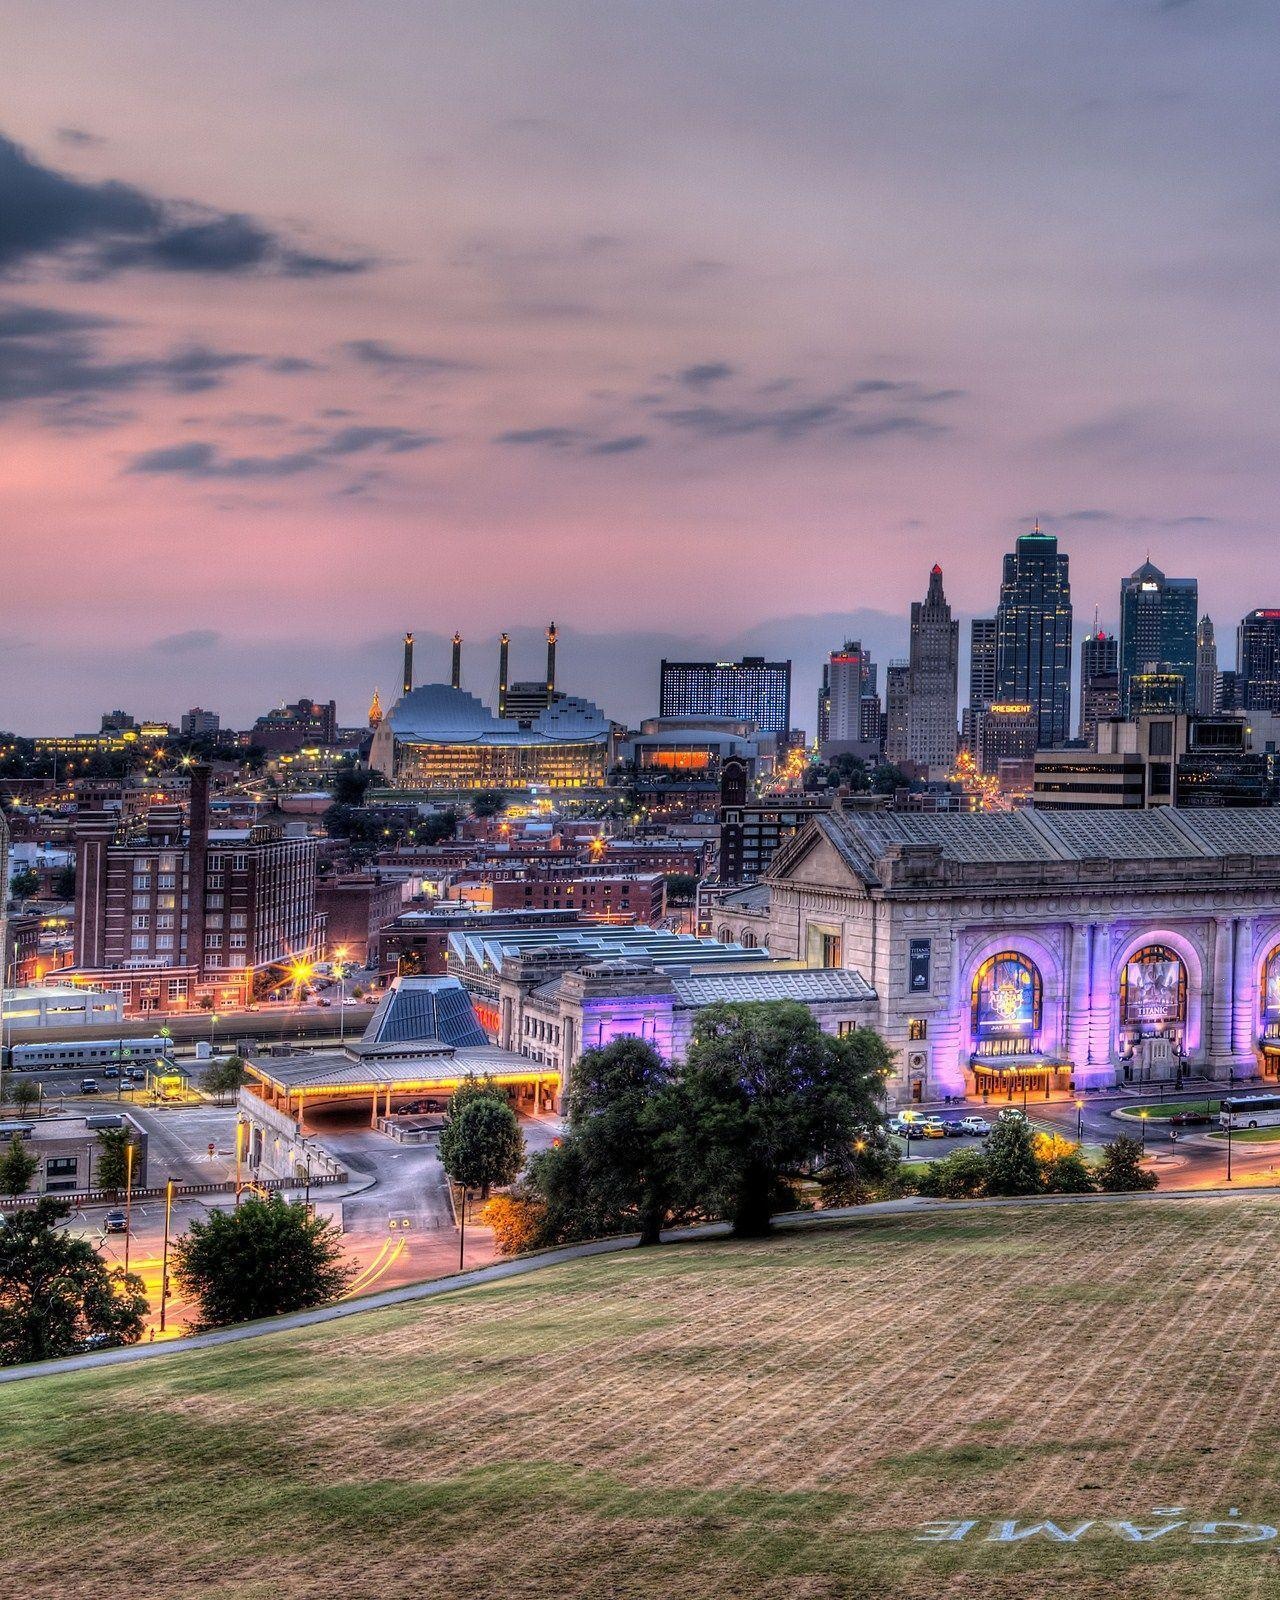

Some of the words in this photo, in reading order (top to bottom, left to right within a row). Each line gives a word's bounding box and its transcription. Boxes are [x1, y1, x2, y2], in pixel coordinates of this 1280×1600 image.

[990, 704, 1032, 713] PRESIDENT
[1138, 1006, 1168, 1015] TITANIC
[914, 1519, 1279, 1543] GAME
